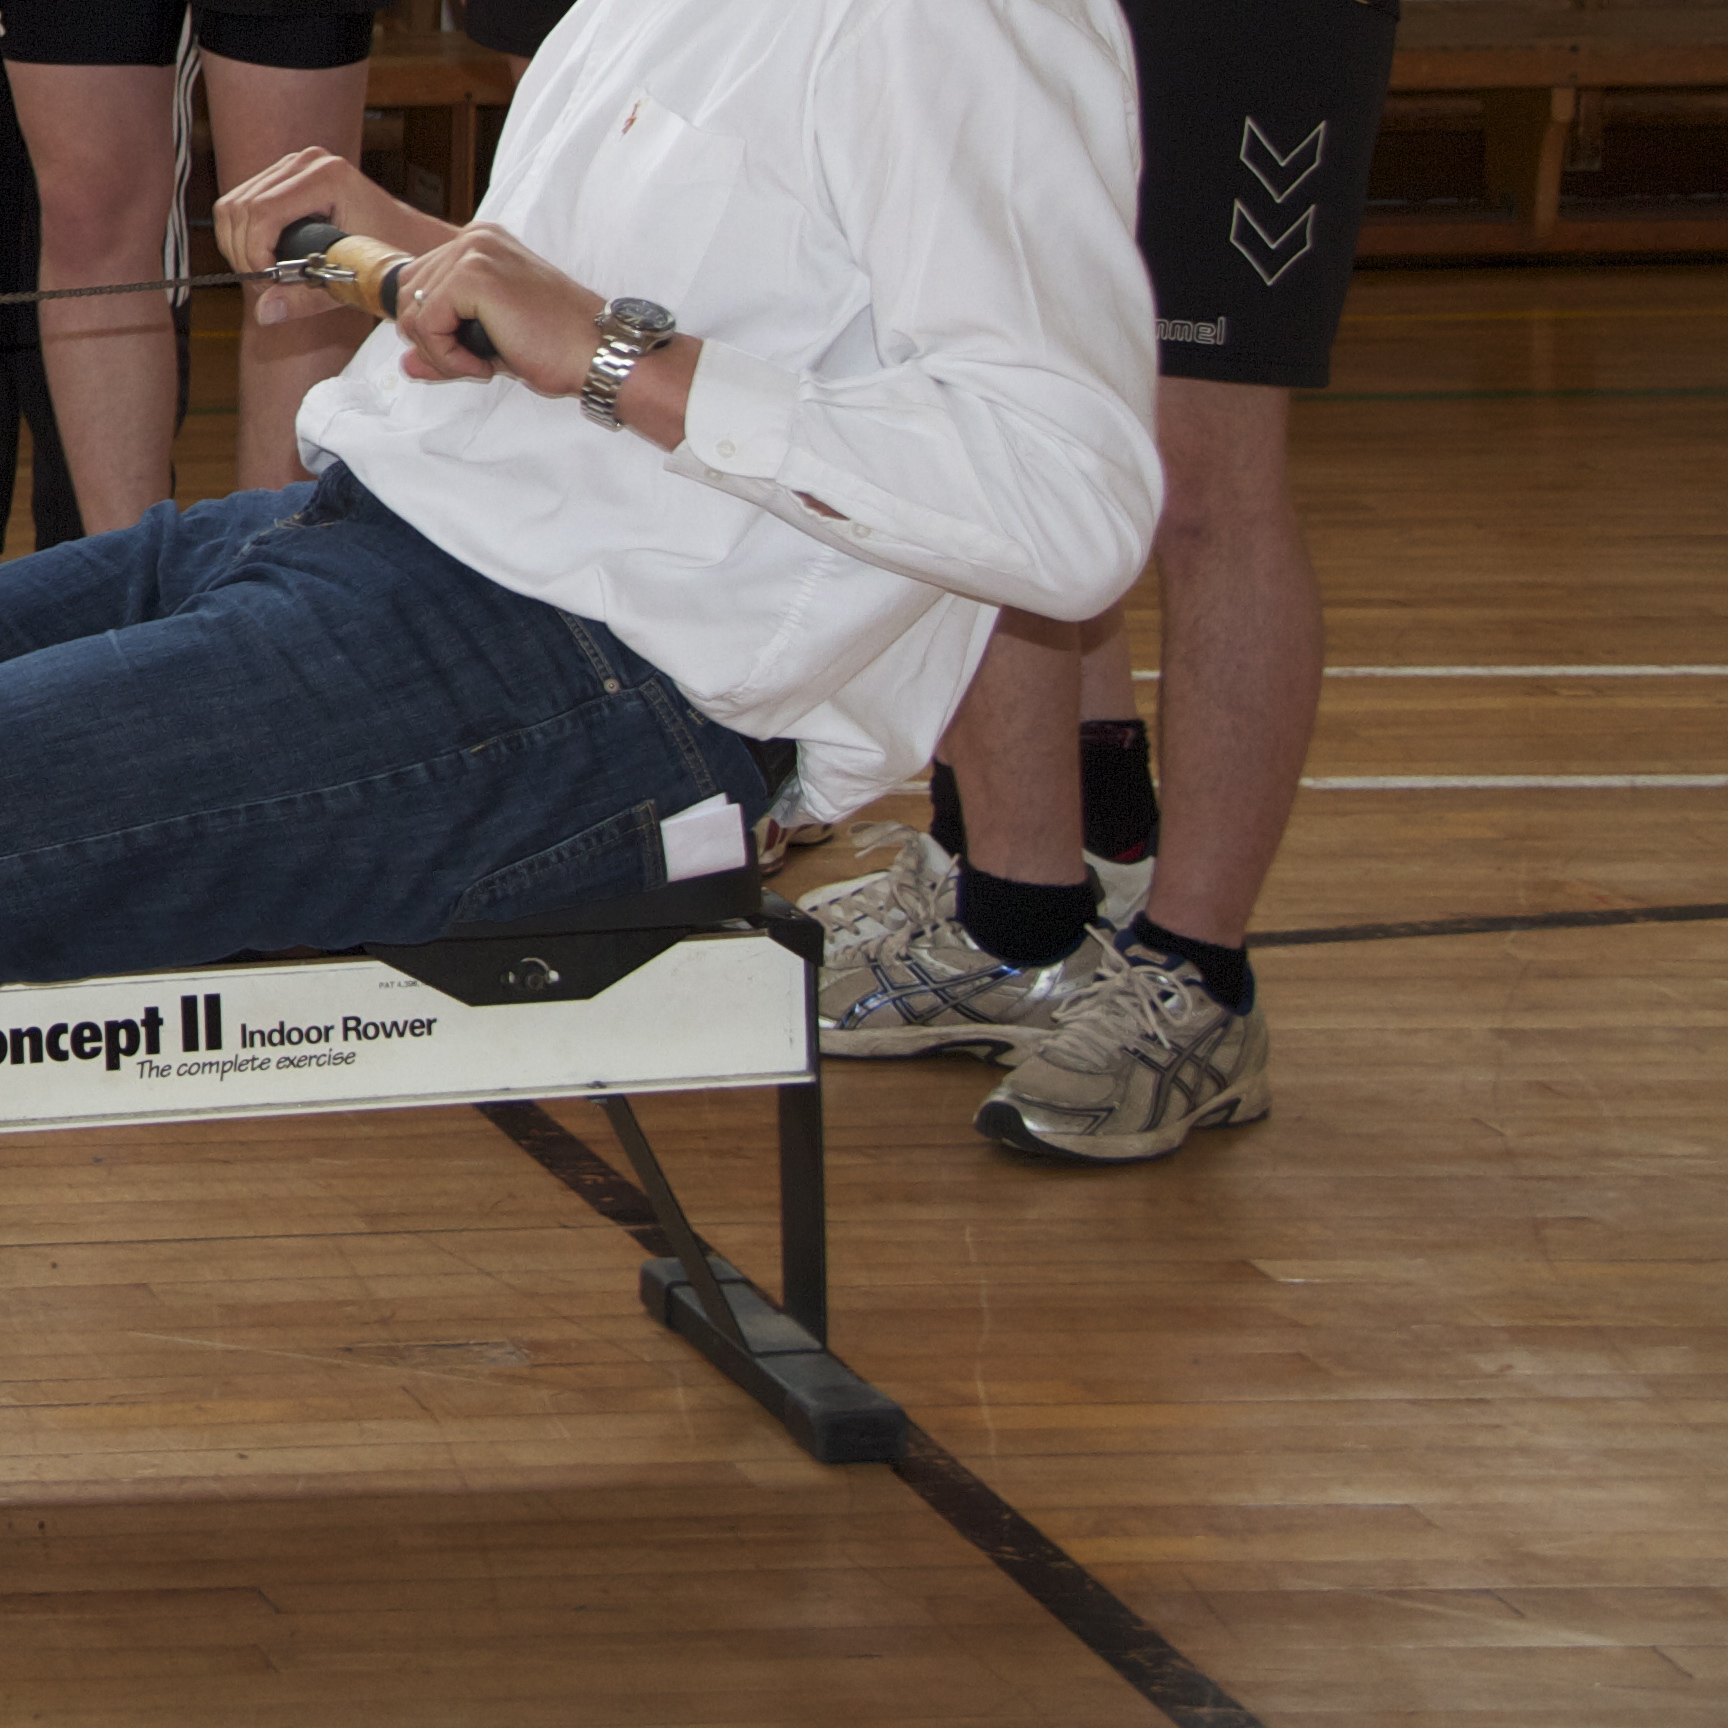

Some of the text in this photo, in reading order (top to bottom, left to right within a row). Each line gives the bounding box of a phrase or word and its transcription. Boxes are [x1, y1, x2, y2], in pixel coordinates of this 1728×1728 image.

[1155, 316, 1226, 345] mmel
[240, 1018, 336, 1049] Indoor
[342, 1014, 438, 1043] Rower
[136, 1048, 357, 1082] The complete exercise
